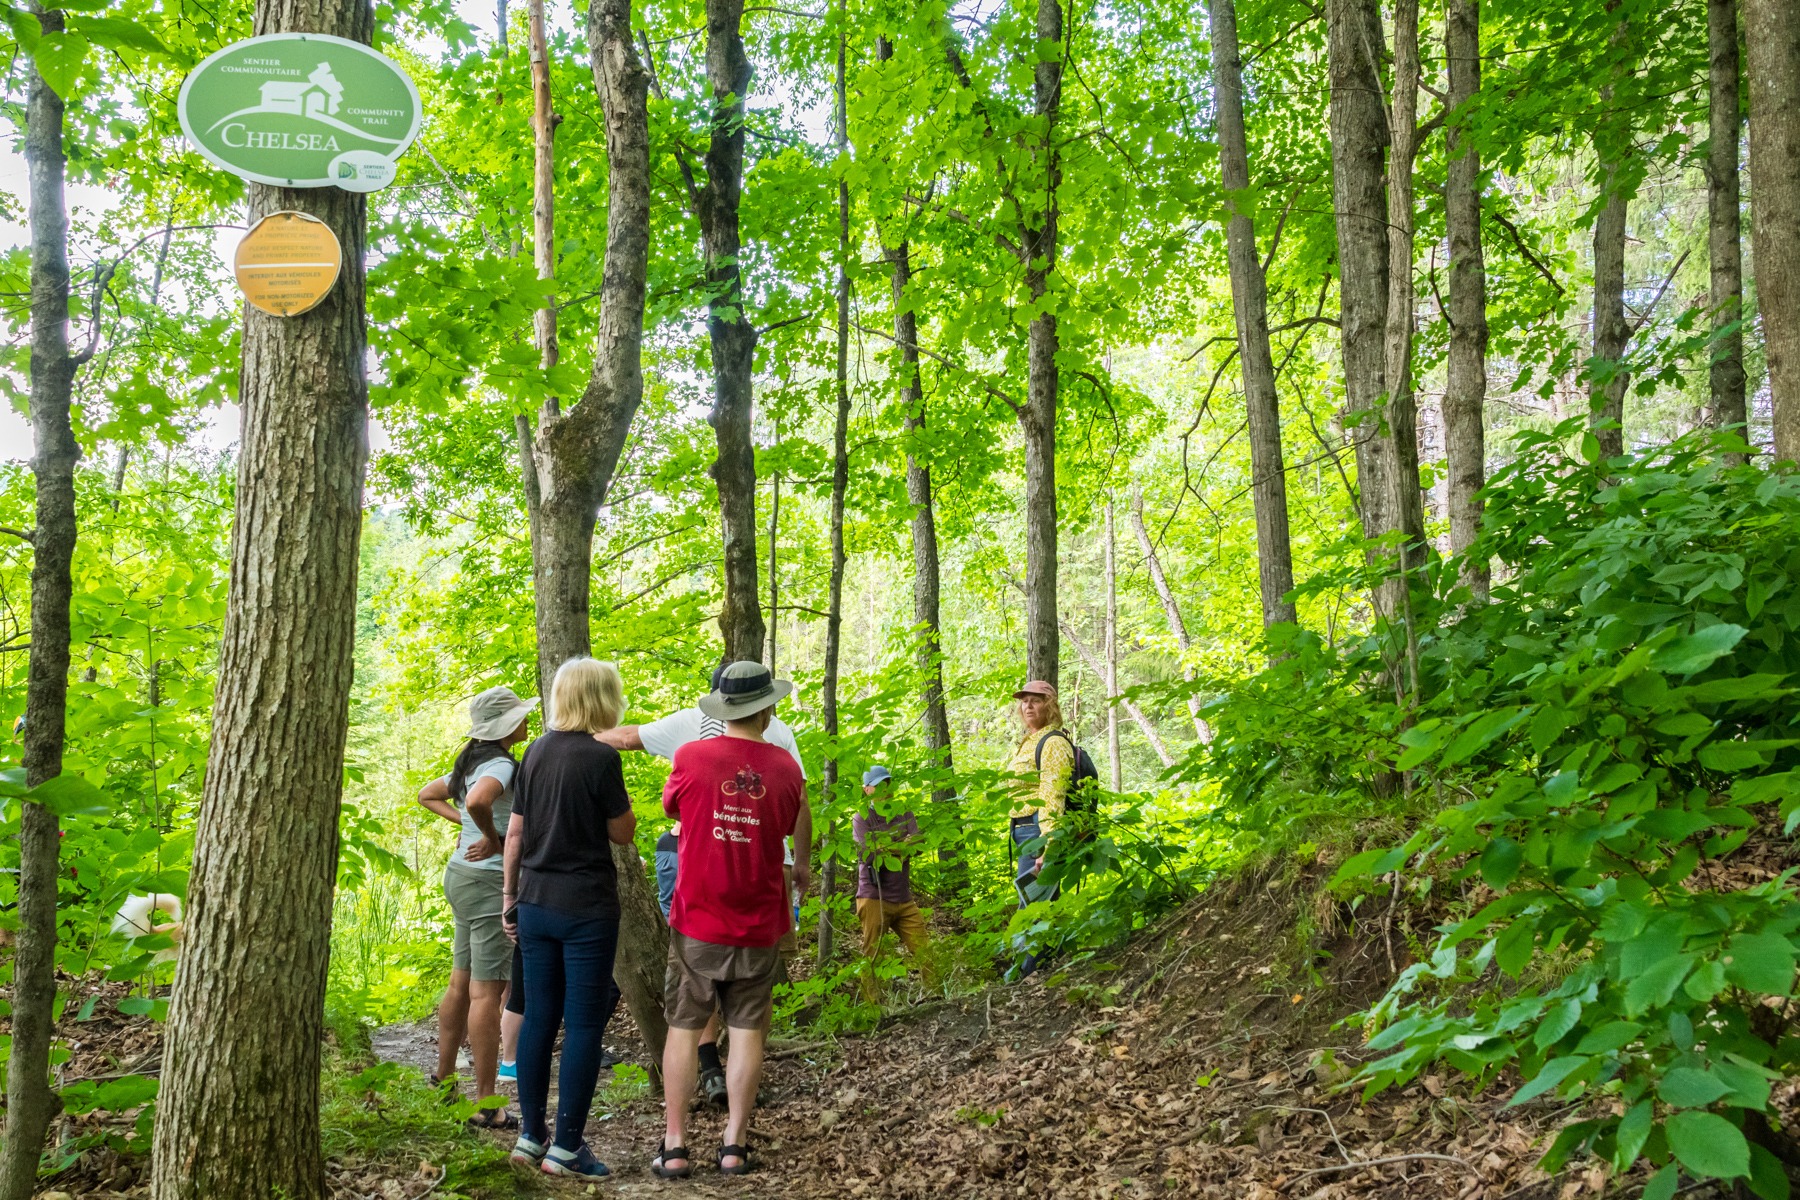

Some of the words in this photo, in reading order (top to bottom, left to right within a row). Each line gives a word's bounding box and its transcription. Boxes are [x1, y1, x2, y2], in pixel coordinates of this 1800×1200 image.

[243, 58, 281, 66] SENTIER
[220, 66, 302, 76] COMMUNAUTAIRE
[347, 107, 405, 117] COMMUNITY
[363, 117, 389, 125] TRAIL
[723, 804, 741, 812] Merci
[713, 809, 760, 825] bénévoles
[725, 828, 743, 837] Hydro
